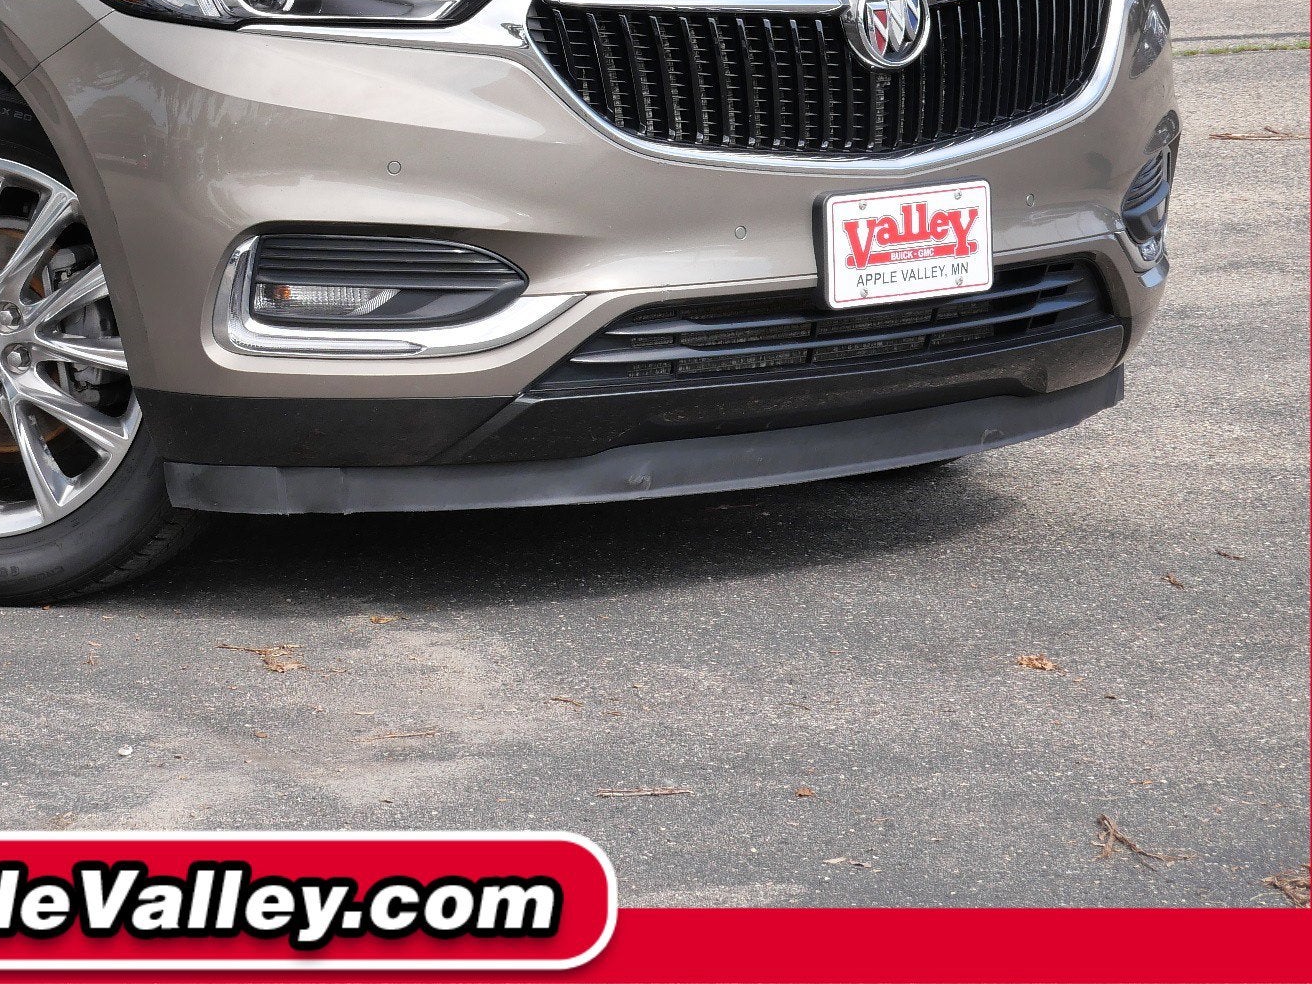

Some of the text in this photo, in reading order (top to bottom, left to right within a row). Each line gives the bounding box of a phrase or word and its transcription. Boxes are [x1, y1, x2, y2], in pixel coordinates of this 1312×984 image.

[843, 202, 979, 269] Valley
[891, 248, 935, 261] BUICK GMC
[856, 262, 969, 287] APPLE VALLEY, MN
